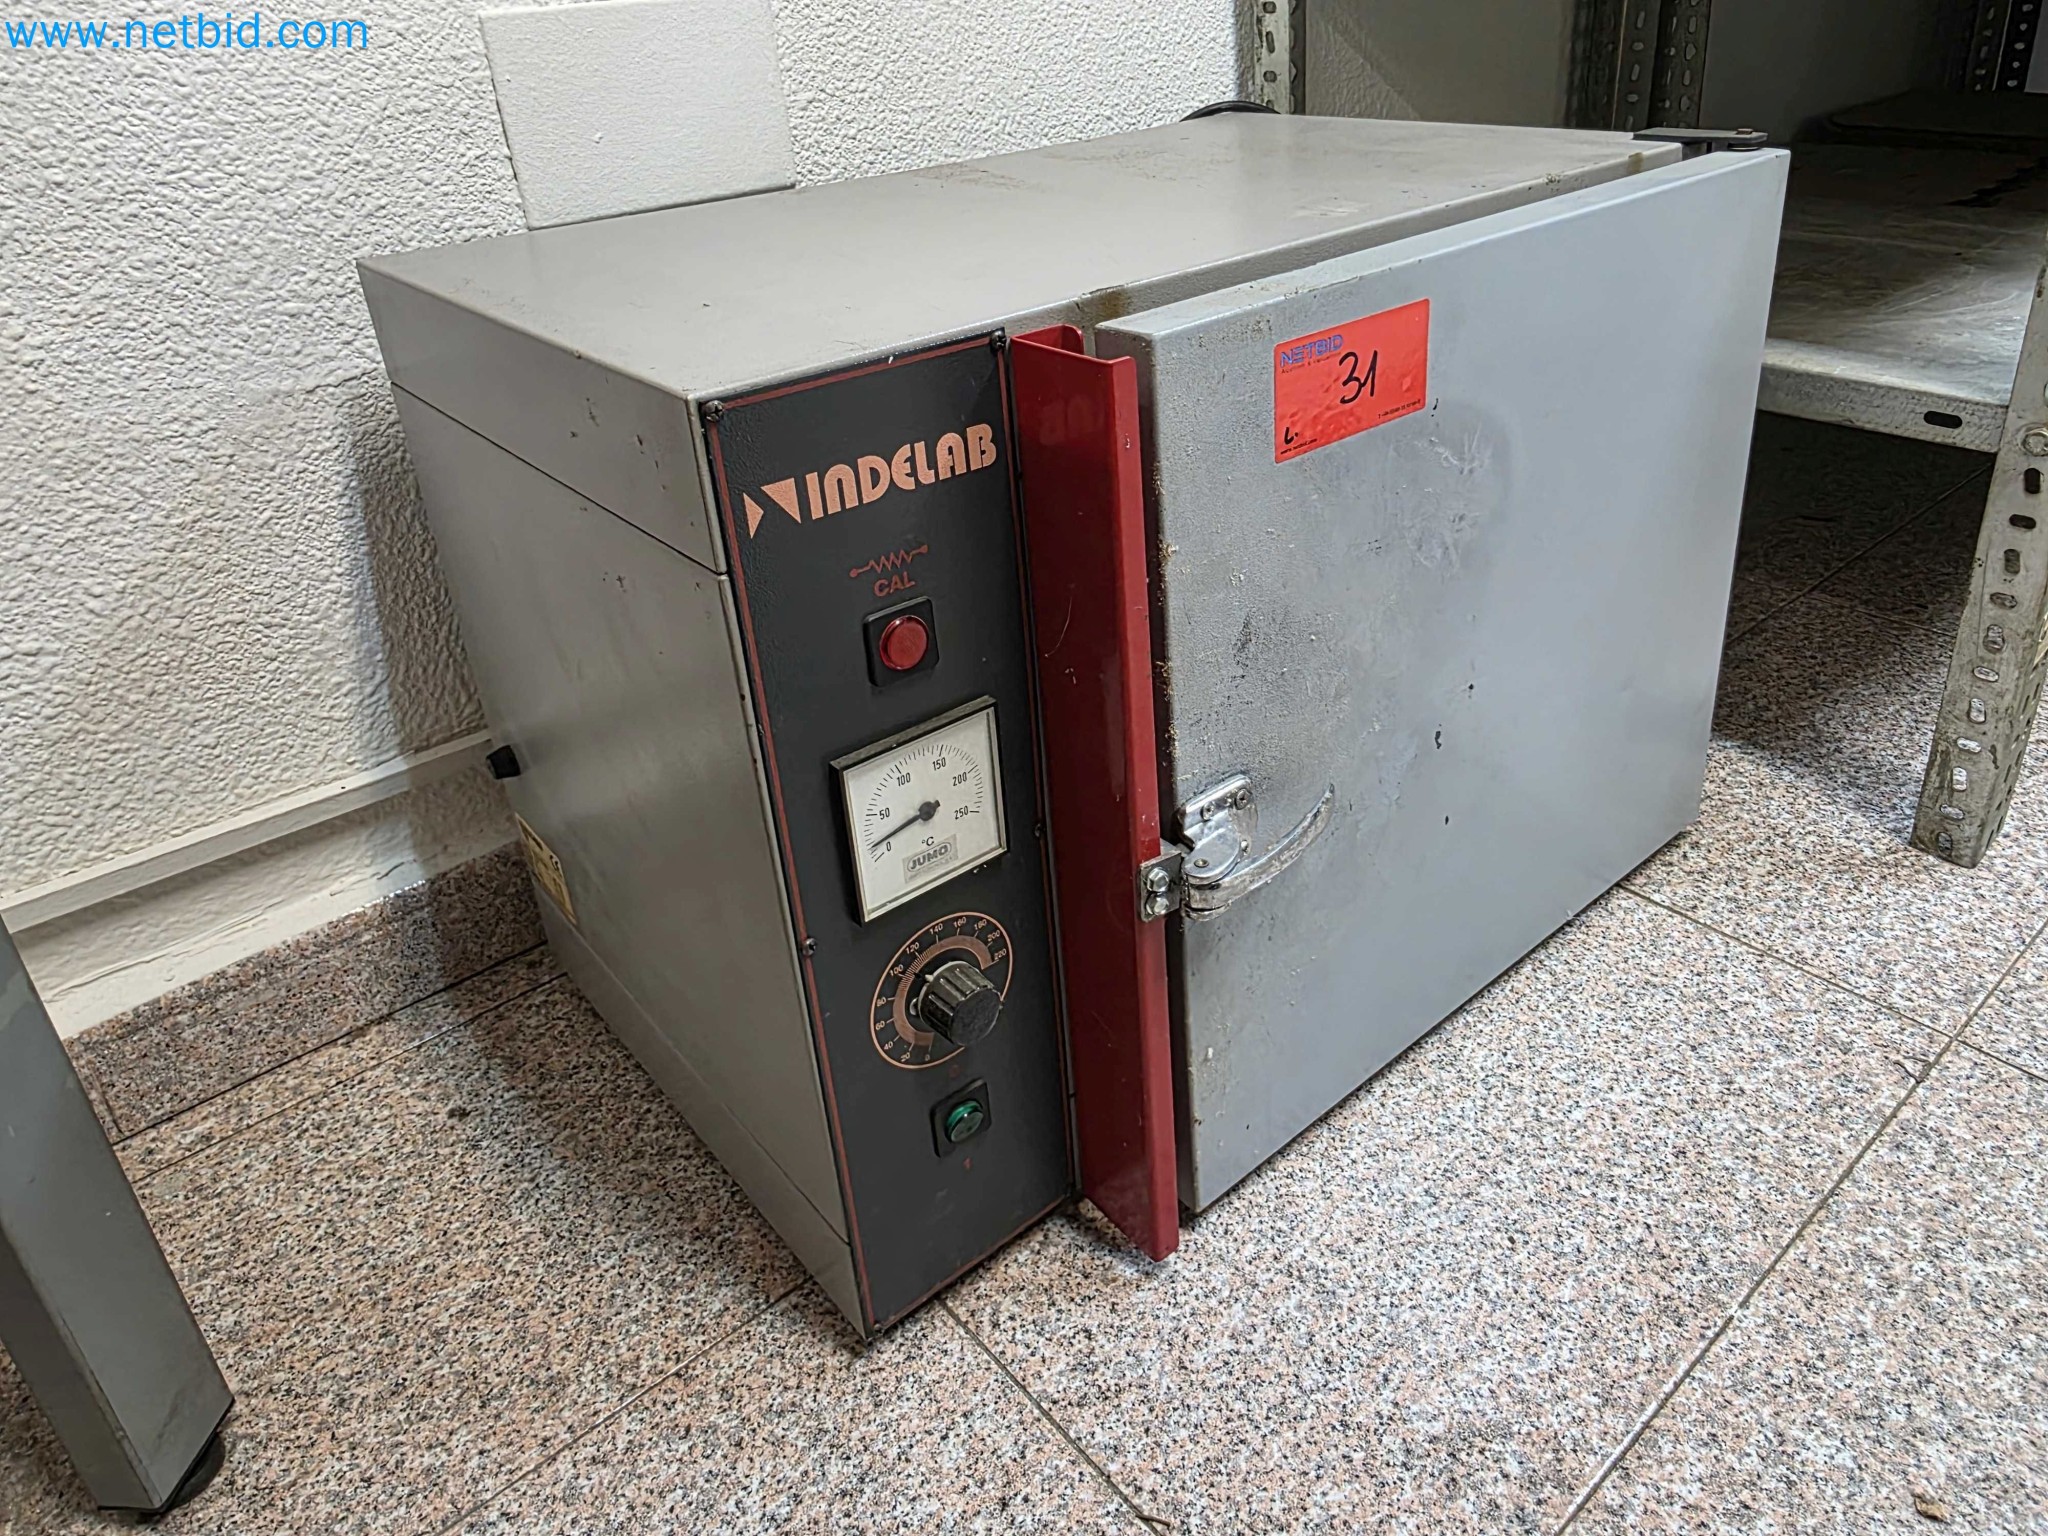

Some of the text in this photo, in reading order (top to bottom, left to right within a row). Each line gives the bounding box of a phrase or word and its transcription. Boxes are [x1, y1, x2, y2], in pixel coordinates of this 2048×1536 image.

[1281, 334, 1344, 367] NETBID
[1339, 350, 1378, 404] 31
[805, 422, 997, 521] INDELAB
[873, 570, 916, 597] CAL
[932, 756, 947, 772] 150
[896, 772, 911, 787] 100
[952, 772, 968, 787] 200
[879, 806, 891, 821] 50
[954, 805, 969, 820] 250
[886, 841, 892, 852] 0
[921, 836, 935, 847] °C
[910, 844, 949, 870] JUMO
[929, 922, 944, 935] 140
[952, 916, 968, 929] 160
[974, 918, 988, 931] 180
[986, 929, 1001, 943] 200
[905, 941, 920, 954] 120
[993, 948, 1007, 961] 220
[889, 964, 905, 977] 100
[876, 997, 887, 1008] 80
[875, 1020, 886, 1031] 60
[883, 1041, 894, 1050] 40
[900, 1051, 911, 1063] 20
[925, 1054, 931, 1062] 0
